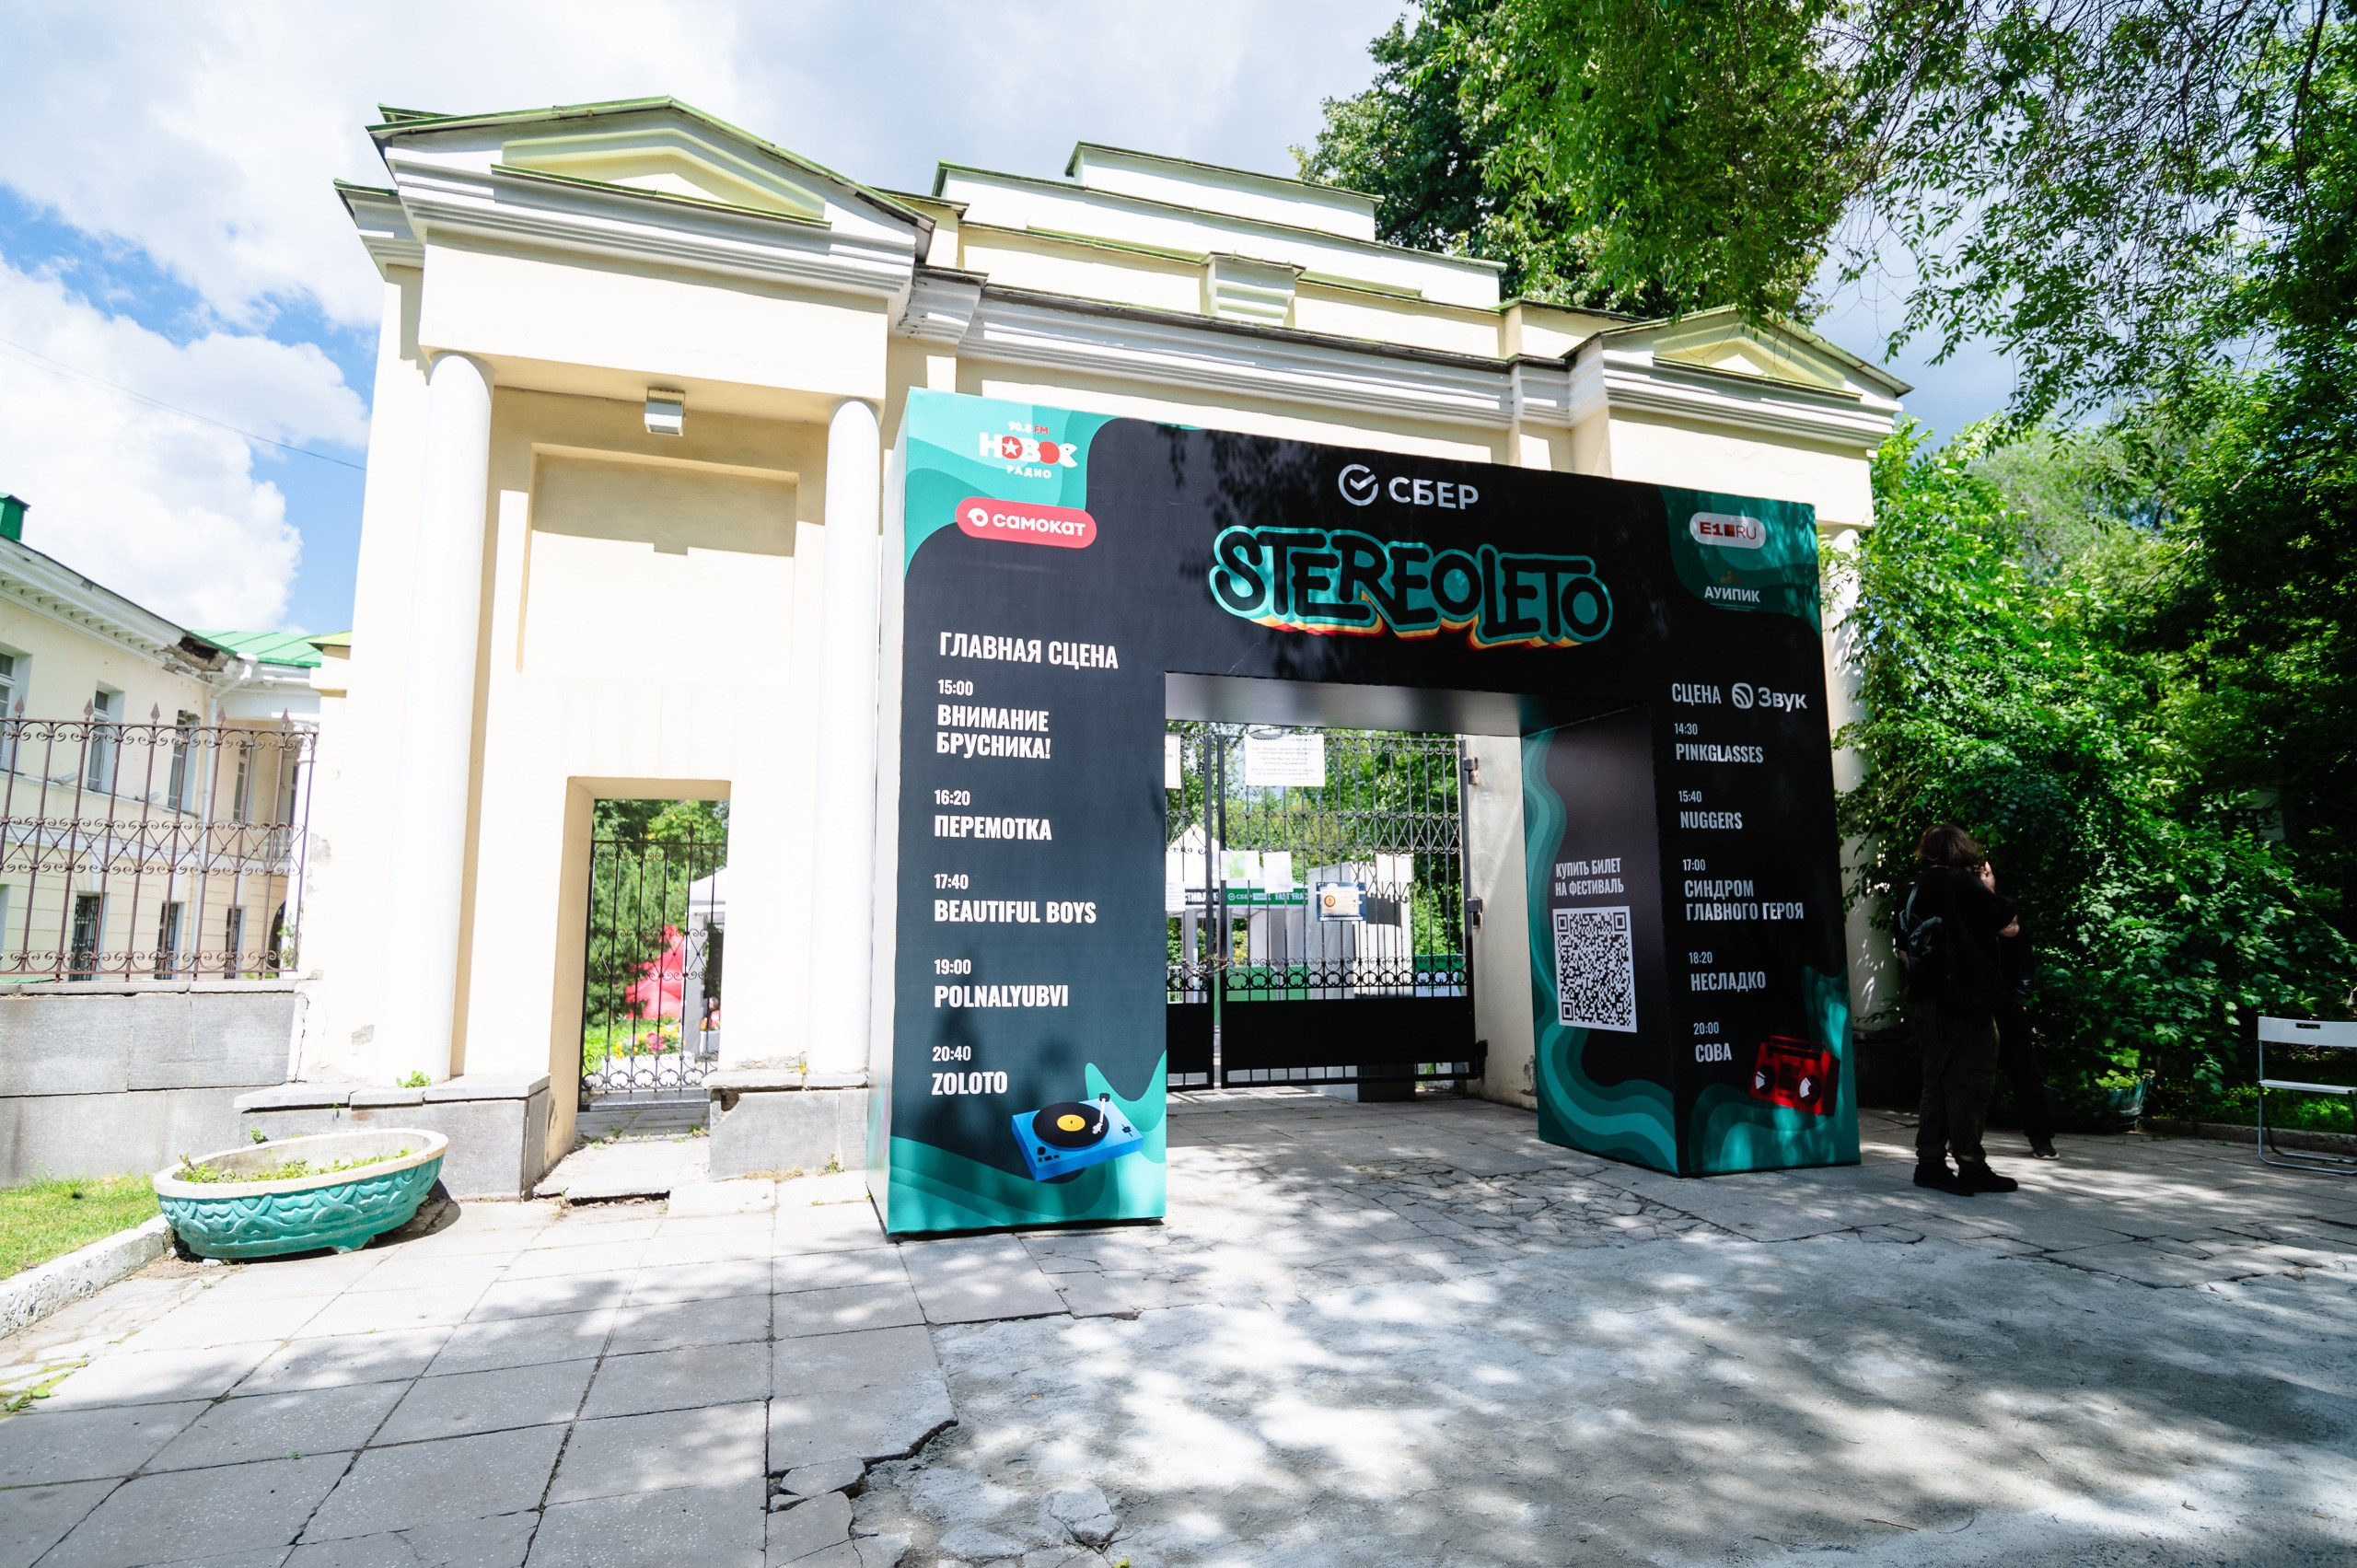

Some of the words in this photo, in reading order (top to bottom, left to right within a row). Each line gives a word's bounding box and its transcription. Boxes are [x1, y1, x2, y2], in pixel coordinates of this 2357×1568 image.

[1007, 421, 1032, 434] 90.8
[1034, 424, 1049, 435] FM
[1006, 464, 1051, 479] РАДИО
[1389, 477, 1478, 509] СБЕР
[1210, 526, 1613, 648] STEREOLETO
[1705, 587, 1759, 602] АУИПИК
[940, 632, 1041, 663] ГЛАВНАЯ
[1049, 641, 1118, 669] СЦЕНА
[938, 679, 973, 696] 15:00
[1672, 683, 1721, 705] СЦЕНА
[1759, 688, 1807, 712] Звук
[937, 704, 1050, 732] ВНИМАНИЕ
[1675, 723, 1698, 735] 14:30
[936, 732, 1051, 760] БРУСНИКА!
[1677, 744, 1763, 762] PINKGLASSES
[935, 790, 970, 806] 16:20
[1678, 791, 1701, 802] 15:40
[935, 815, 1051, 840] ПЕРЕМОТКА
[1680, 812, 1742, 829] NUGGERS
[1556, 861, 1589, 879] КУПИТЬ
[1591, 857, 1621, 875] БИЛЕТ
[1683, 859, 1705, 871] 17:00
[935, 874, 969, 889] 17:40
[1555, 881, 1567, 897] НА
[1569, 877, 1625, 896] ФЕСТИВАЛЬ
[1685, 880, 1753, 900] СИНДРОМ
[935, 900, 1040, 923] BEAUTIFUL
[1047, 901, 1096, 923] BOYS
[1687, 903, 1758, 920] ГЛАВНОГО
[1763, 902, 1803, 920] ГЕРОЯ
[935, 959, 971, 974] 19:00
[1689, 952, 1713, 964] 18:20
[1691, 971, 1765, 992] НЕСЛАДКО
[935, 985, 1068, 1007] POLNALYUBVI
[1694, 1022, 1719, 1035] 20:00
[933, 1046, 970, 1062] 20:40
[1696, 1043, 1732, 1062] СОВА
[932, 1071, 1007, 1095] ZOLOTO
